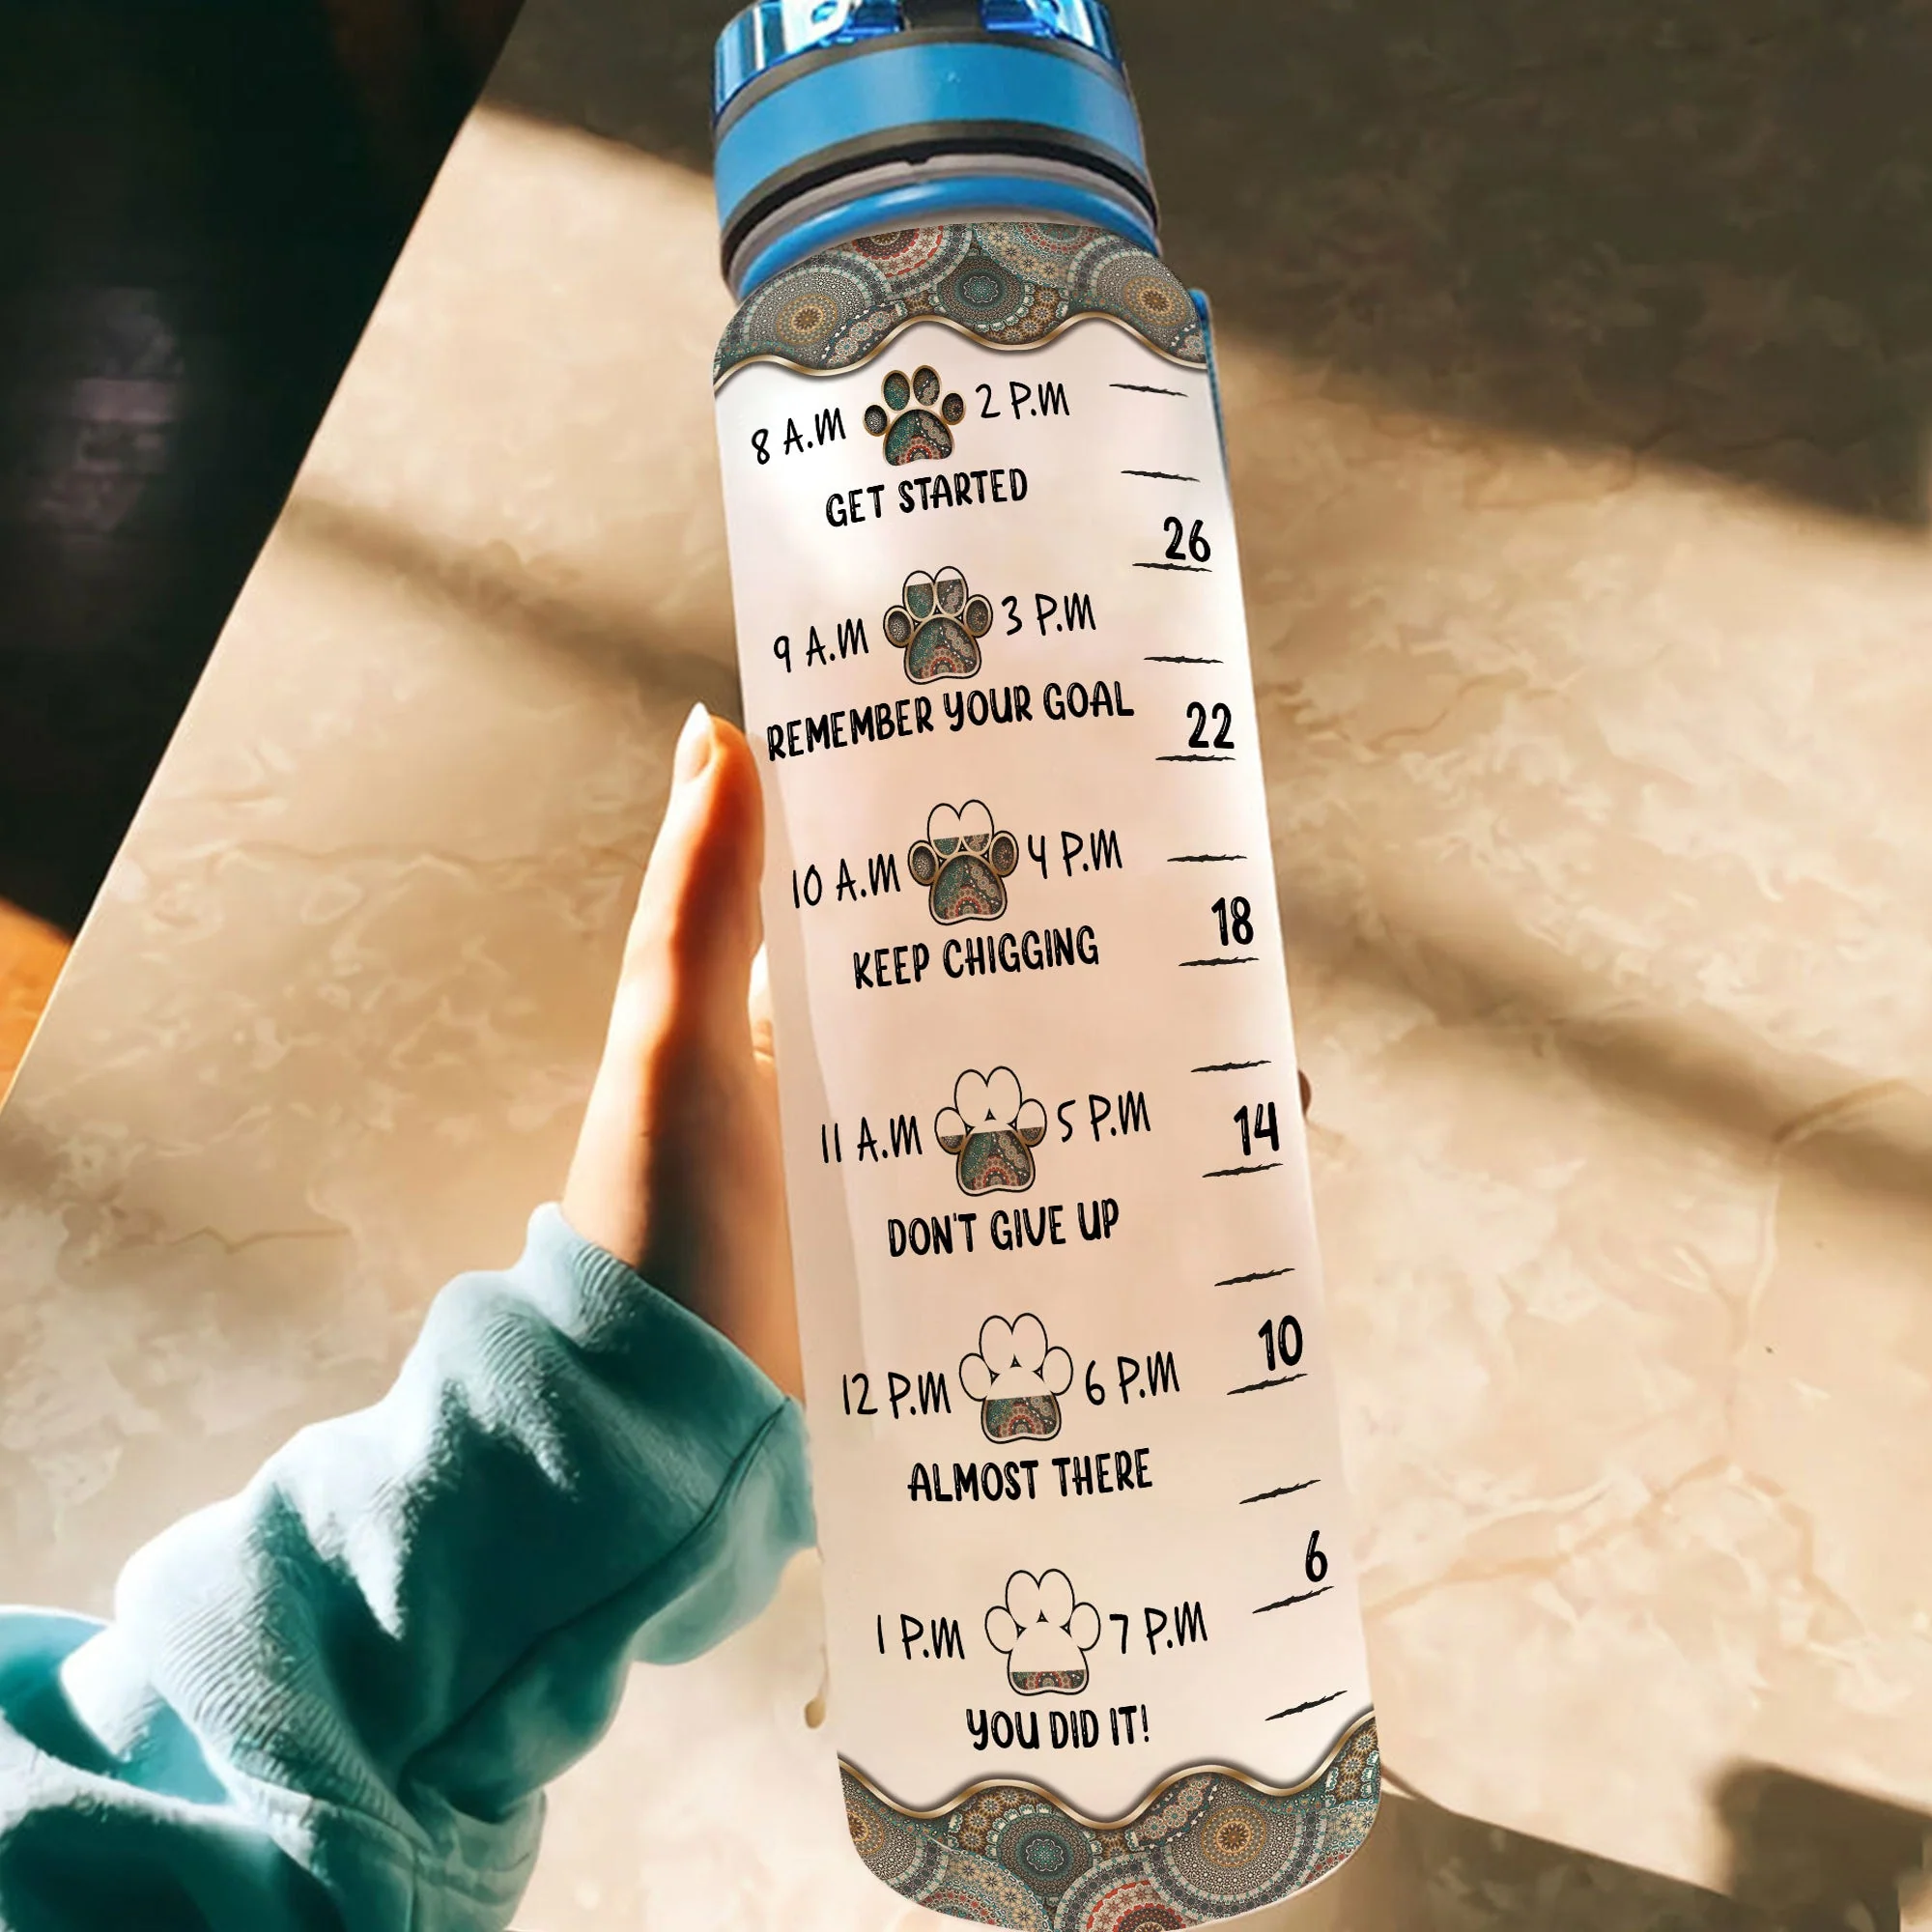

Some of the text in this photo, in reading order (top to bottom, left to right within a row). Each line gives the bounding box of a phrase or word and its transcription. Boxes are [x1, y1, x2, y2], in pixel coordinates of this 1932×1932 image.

[976, 381, 1070, 420] 2 P.M
[750, 406, 847, 467] 8 A.M
[825, 468, 1028, 527] GET STARTED
[1163, 516, 1212, 563] 26
[1001, 592, 1096, 637] 3 P.M
[773, 617, 869, 673] 9 A.M
[766, 680, 1135, 762] REMEMBER YOUR GOAL
[1186, 701, 1236, 750] 22
[792, 853, 901, 909] 10 A.M
[1027, 828, 1122, 880] 4 P.M
[1210, 895, 1255, 947] 18
[853, 924, 1099, 990] KEEP CHIGGING
[821, 1114, 923, 1164] 11 A.M
[1057, 1090, 1151, 1143] 5 P.M
[1233, 1101, 1280, 1156] 14
[887, 1197, 1120, 1258] DON'T GIVE UP
[1258, 1315, 1303, 1372] 10
[842, 1371, 952, 1420] 12 P.M
[1085, 1350, 1180, 1406] 6 P.M
[907, 1447, 1153, 1502] ALMOST THERE
[1305, 1529, 1328, 1583] 6
[877, 1613, 966, 1661] 1 P.M
[1109, 1601, 1208, 1656] 7 P.M
[965, 1704, 1150, 1751] YOU DID IT!
